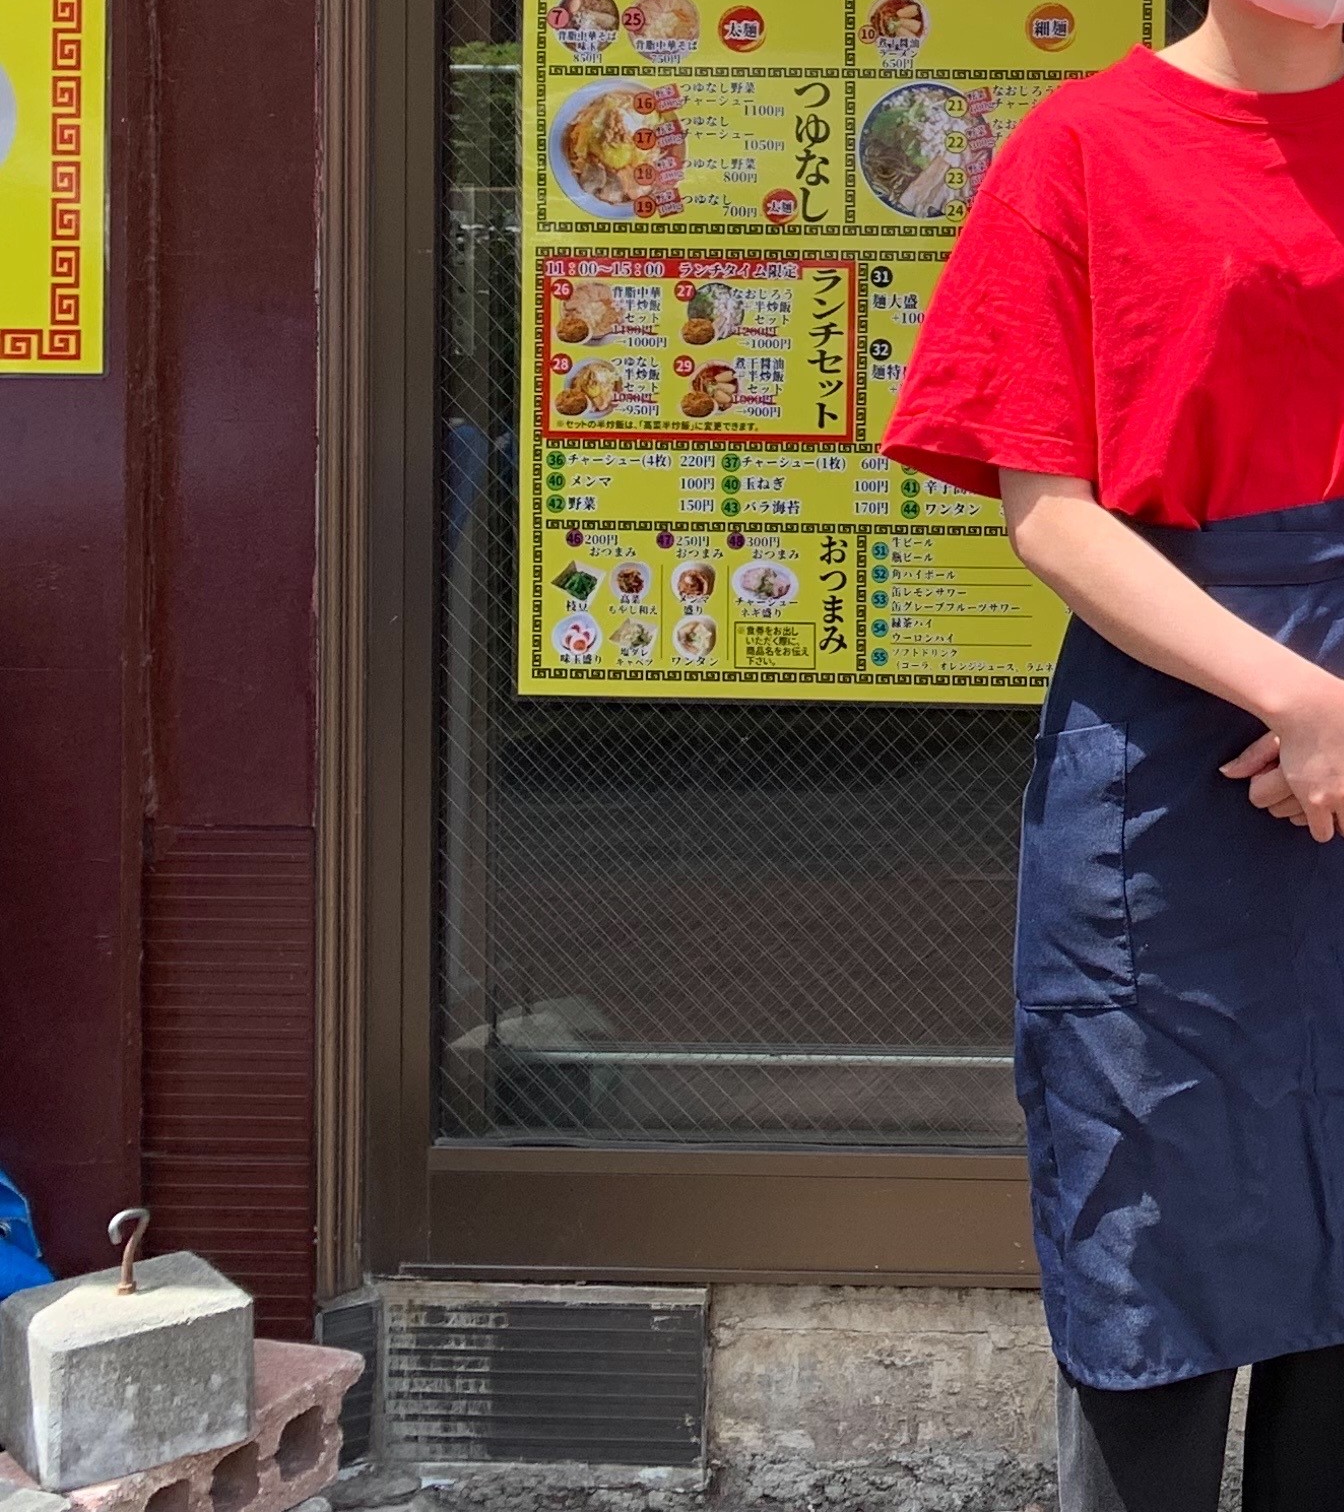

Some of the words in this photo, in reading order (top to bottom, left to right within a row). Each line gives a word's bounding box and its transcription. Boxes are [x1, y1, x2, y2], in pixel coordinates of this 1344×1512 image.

[552, 10, 562, 24] 7
[624, 14, 641, 26] 25
[861, 29, 874, 39] 10
[637, 98, 652, 109] 16
[948, 100, 963, 111] 21
[681, 117, 730, 127] つゆなし
[638, 134, 651, 144] 17
[948, 137, 963, 148] 22
[794, 82, 831, 223] つゆなし
[637, 169, 651, 179] 18
[948, 173, 963, 184] 23
[682, 195, 732, 205] つゆなし
[638, 202, 651, 212] 19
[948, 206, 962, 217] 24
[679, 263, 798, 278] ランチタイム限定
[873, 272, 889, 282] 31
[554, 283, 569, 295] 26
[678, 285, 693, 297] 27
[624, 314, 659, 323] セット
[755, 315, 789, 325] セット
[807, 269, 845, 429] ランチセット
[873, 345, 888, 355] 32
[553, 360, 568, 370] 28
[611, 357, 659, 368] つゆなし
[677, 361, 692, 372] 29
[624, 383, 659, 392] セット
[747, 384, 782, 394] セット
[549, 456, 563, 464] 36
[680, 455, 716, 468] 220円
[724, 458, 738, 467] 37
[861, 459, 889, 471] 60円
[549, 477, 563, 485] 40
[571, 475, 611, 487] メンマ
[680, 477, 715, 490] 100円
[746, 477, 785, 489] 玉ねぎ
[854, 480, 889, 494] 100円
[904, 484, 917, 493] 41
[549, 500, 562, 508] 42
[568, 497, 596, 511] 野菜
[680, 500, 714, 512] 150円
[724, 504, 738, 512] 43
[854, 502, 889, 515] 170円
[904, 505, 918, 515] 44
[925, 503, 980, 515] ワンタン
[585, 534, 618, 545] 200円
[746, 536, 780, 547] 300円
[590, 547, 636, 557] おつまみ
[676, 548, 723, 558] おつまみ
[752, 549, 799, 559] おつまみ
[875, 547, 886, 555] 51
[875, 570, 886, 578] 52
[819, 536, 847, 654] おつまみ
[875, 595, 886, 604] 53
[874, 624, 886, 632] 54
[874, 652, 886, 661] 55
